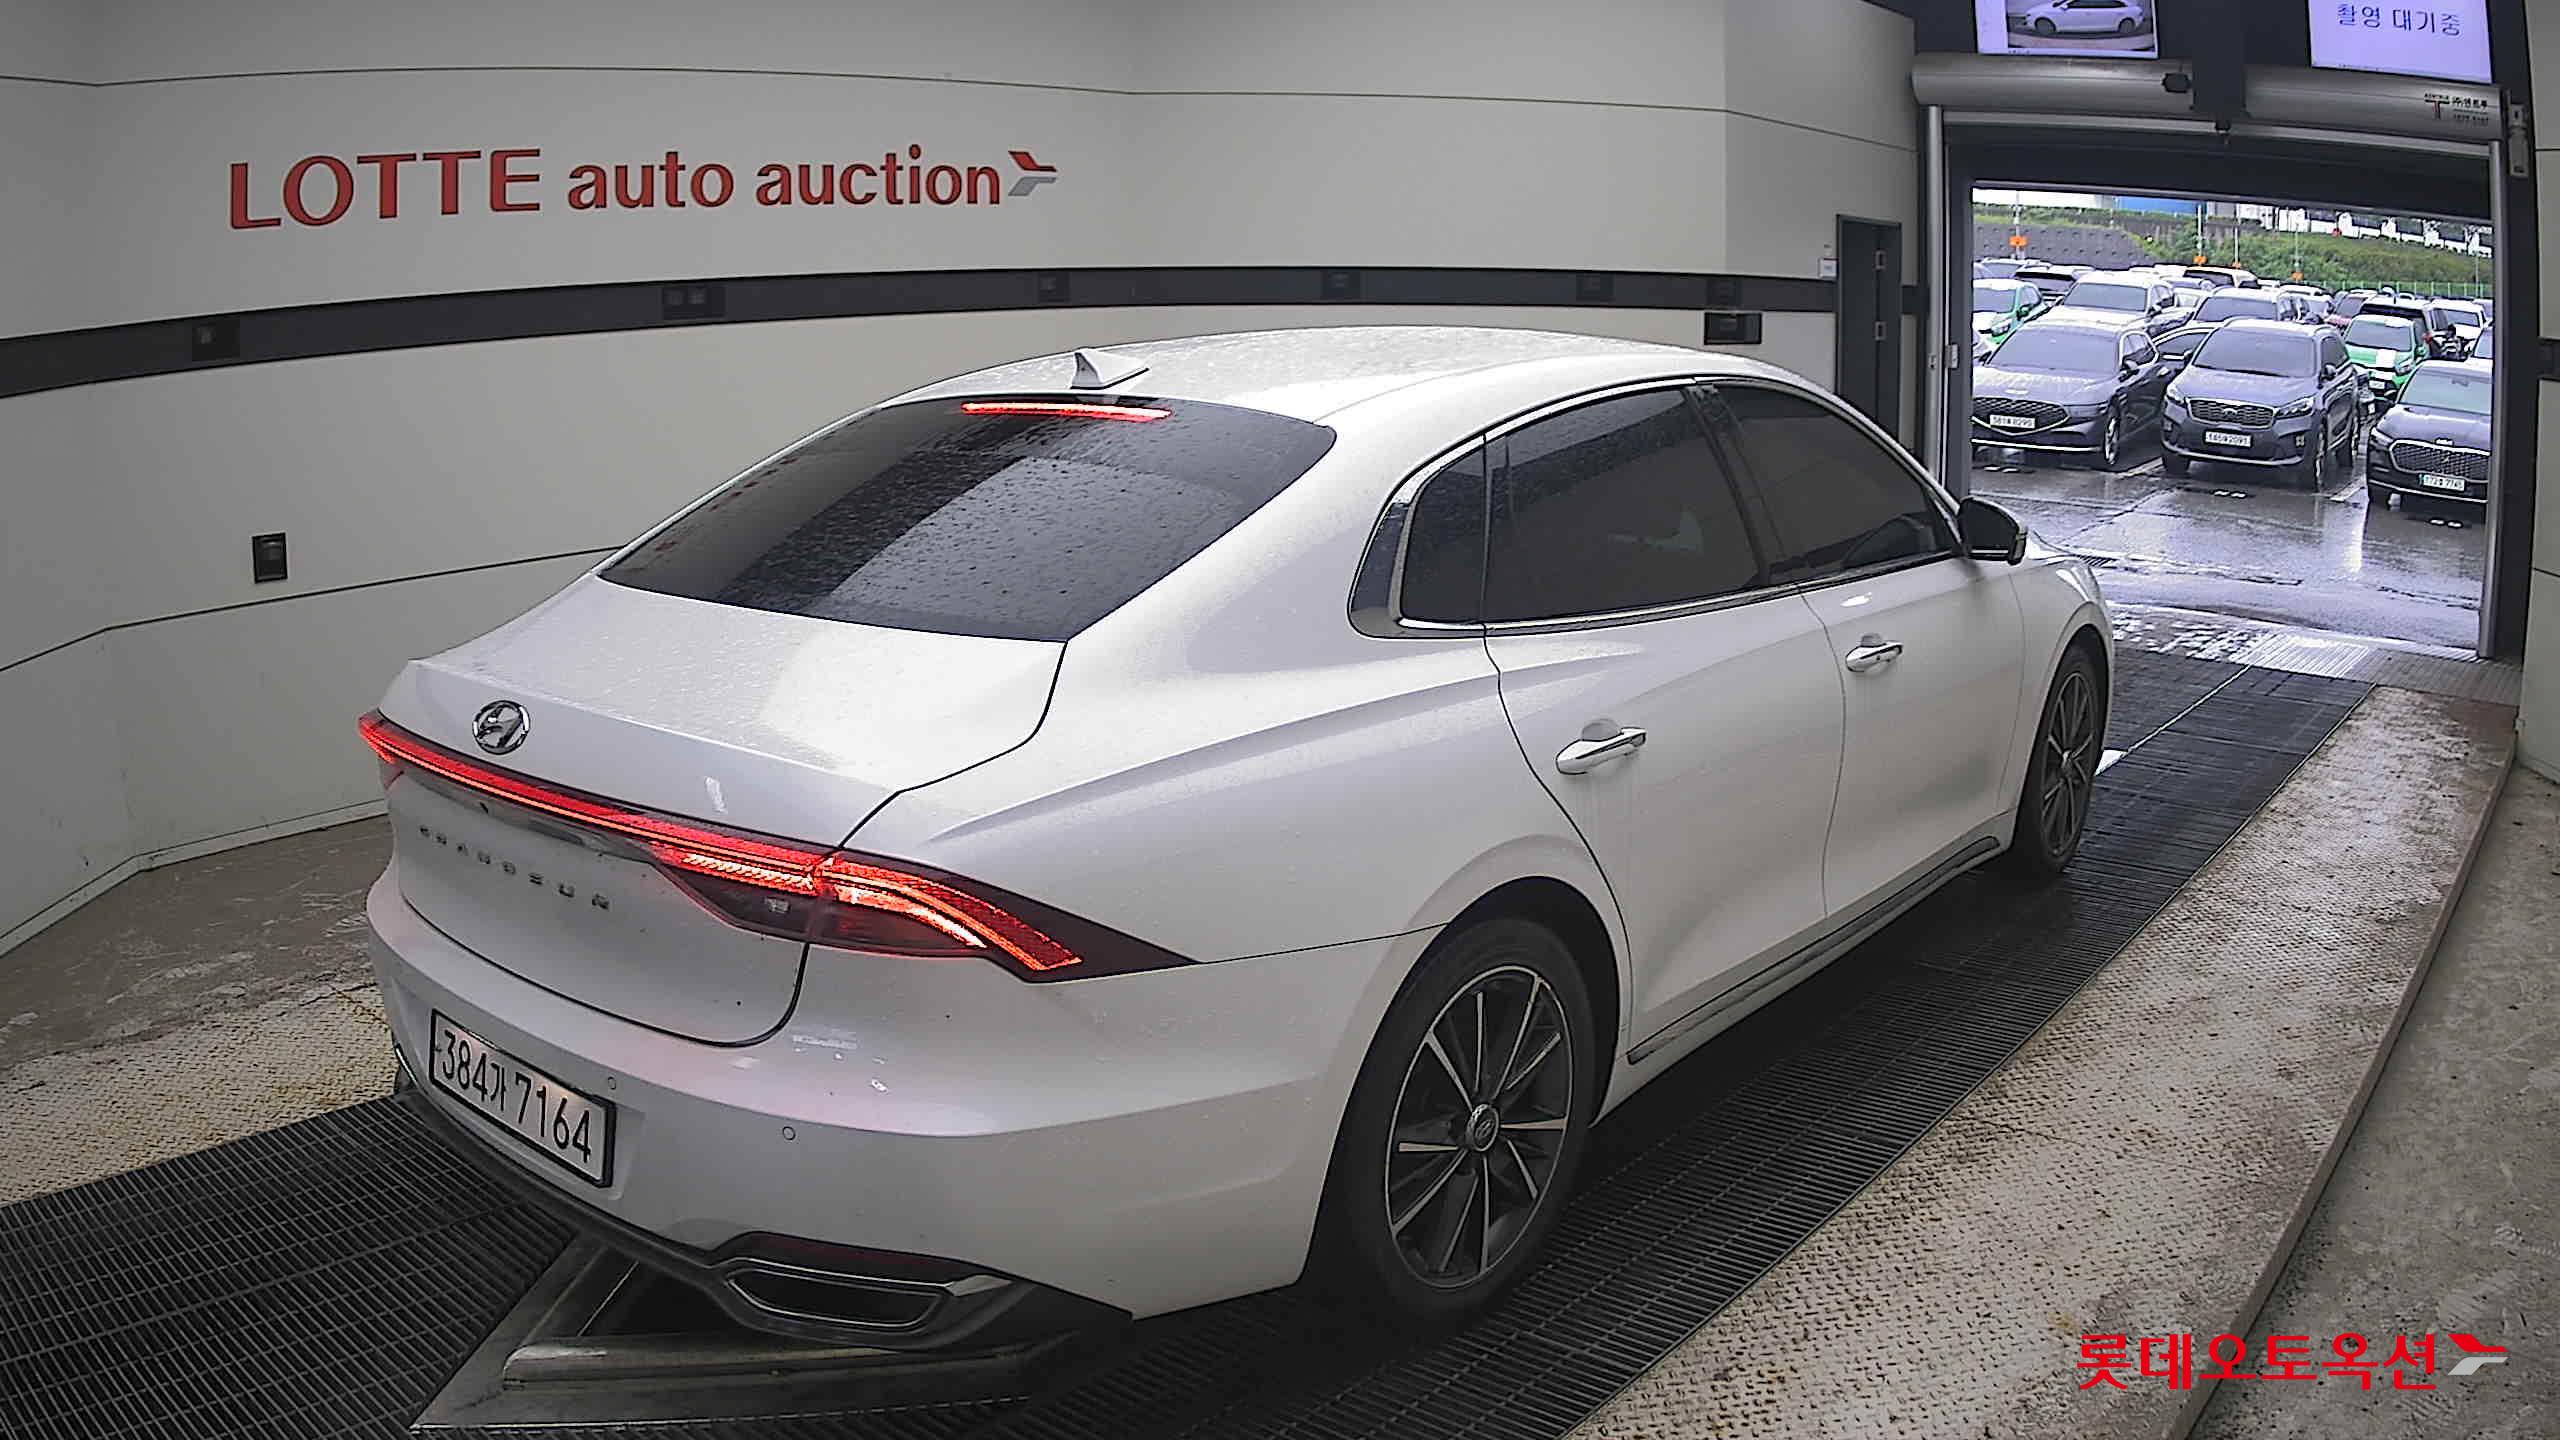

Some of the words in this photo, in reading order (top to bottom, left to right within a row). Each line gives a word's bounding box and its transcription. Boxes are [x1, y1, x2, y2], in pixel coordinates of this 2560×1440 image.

[2338, 4, 2381, 29] 촬영
[2392, 9, 2461, 37] 대기중
[231, 149, 541, 230] LOTTE
[568, 151, 734, 209] auto
[756, 144, 1000, 205] auction
